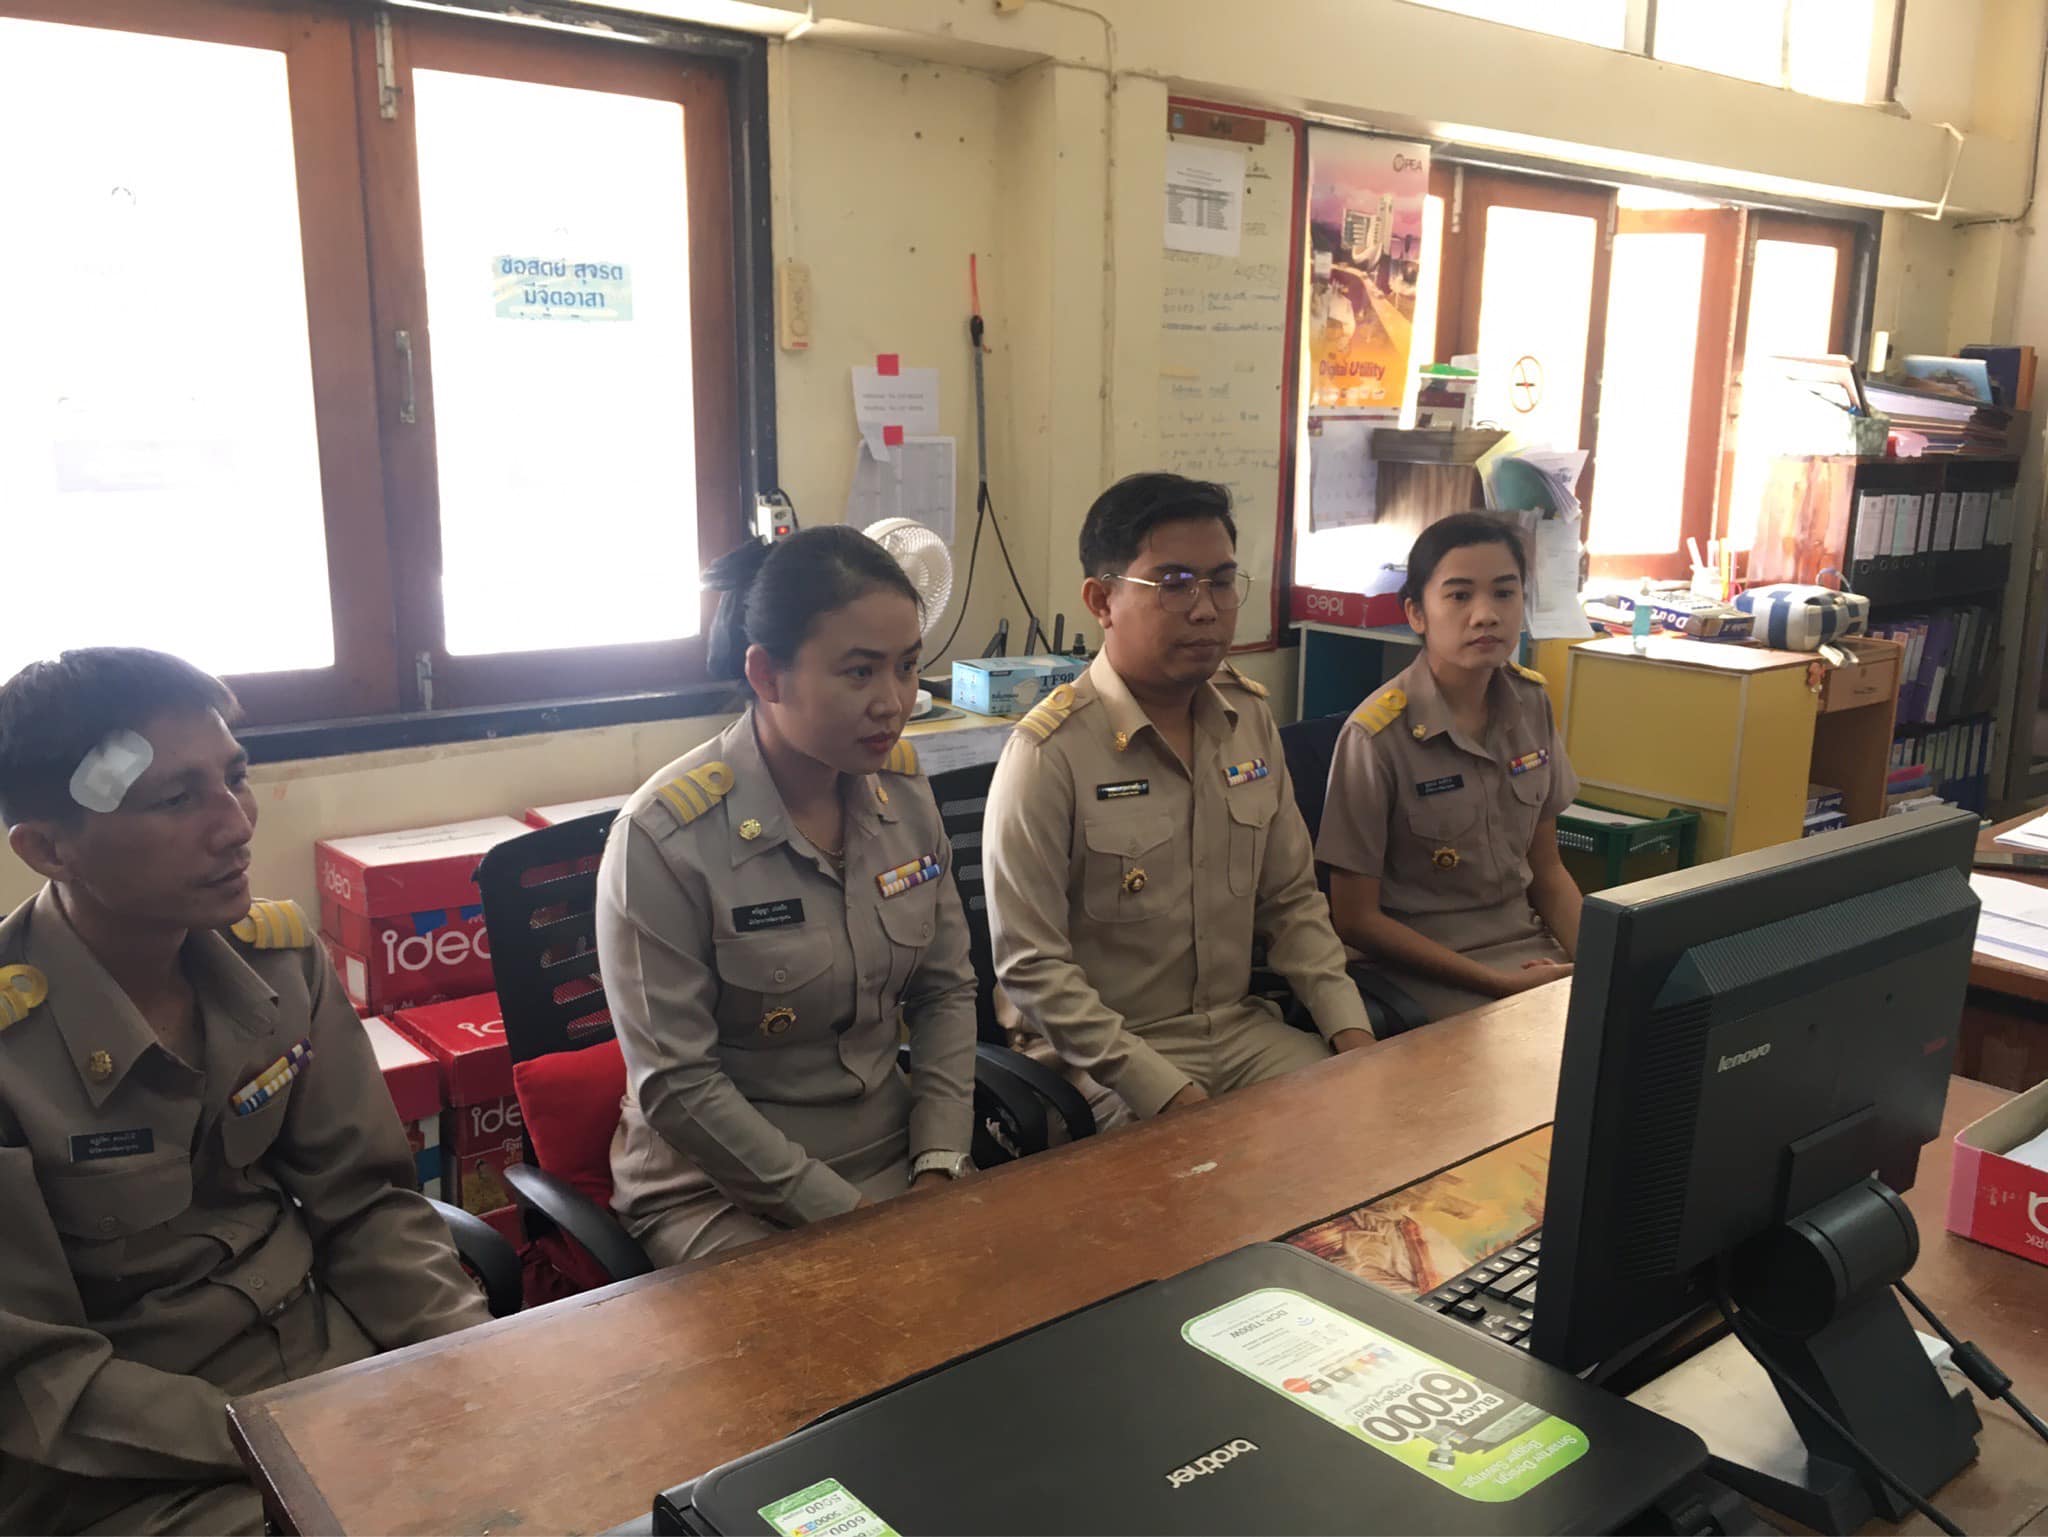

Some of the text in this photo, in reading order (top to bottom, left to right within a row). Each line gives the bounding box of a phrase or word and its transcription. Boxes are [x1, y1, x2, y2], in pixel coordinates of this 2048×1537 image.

[1349, 360, 1386, 381] Utility
[1305, 594, 1345, 617] idea
[1040, 671, 1075, 687] TF98
[324, 861, 351, 900] idea
[1717, 1042, 1772, 1073] lenovo
[471, 1097, 524, 1137] ide
[1362, 1372, 1479, 1443] 6000
[1448, 1394, 1500, 1424] BLACK
[1165, 1438, 1260, 1490] brother
[1506, 1439, 1544, 1463] Bigger
[1532, 1433, 1578, 1466] Smarter
